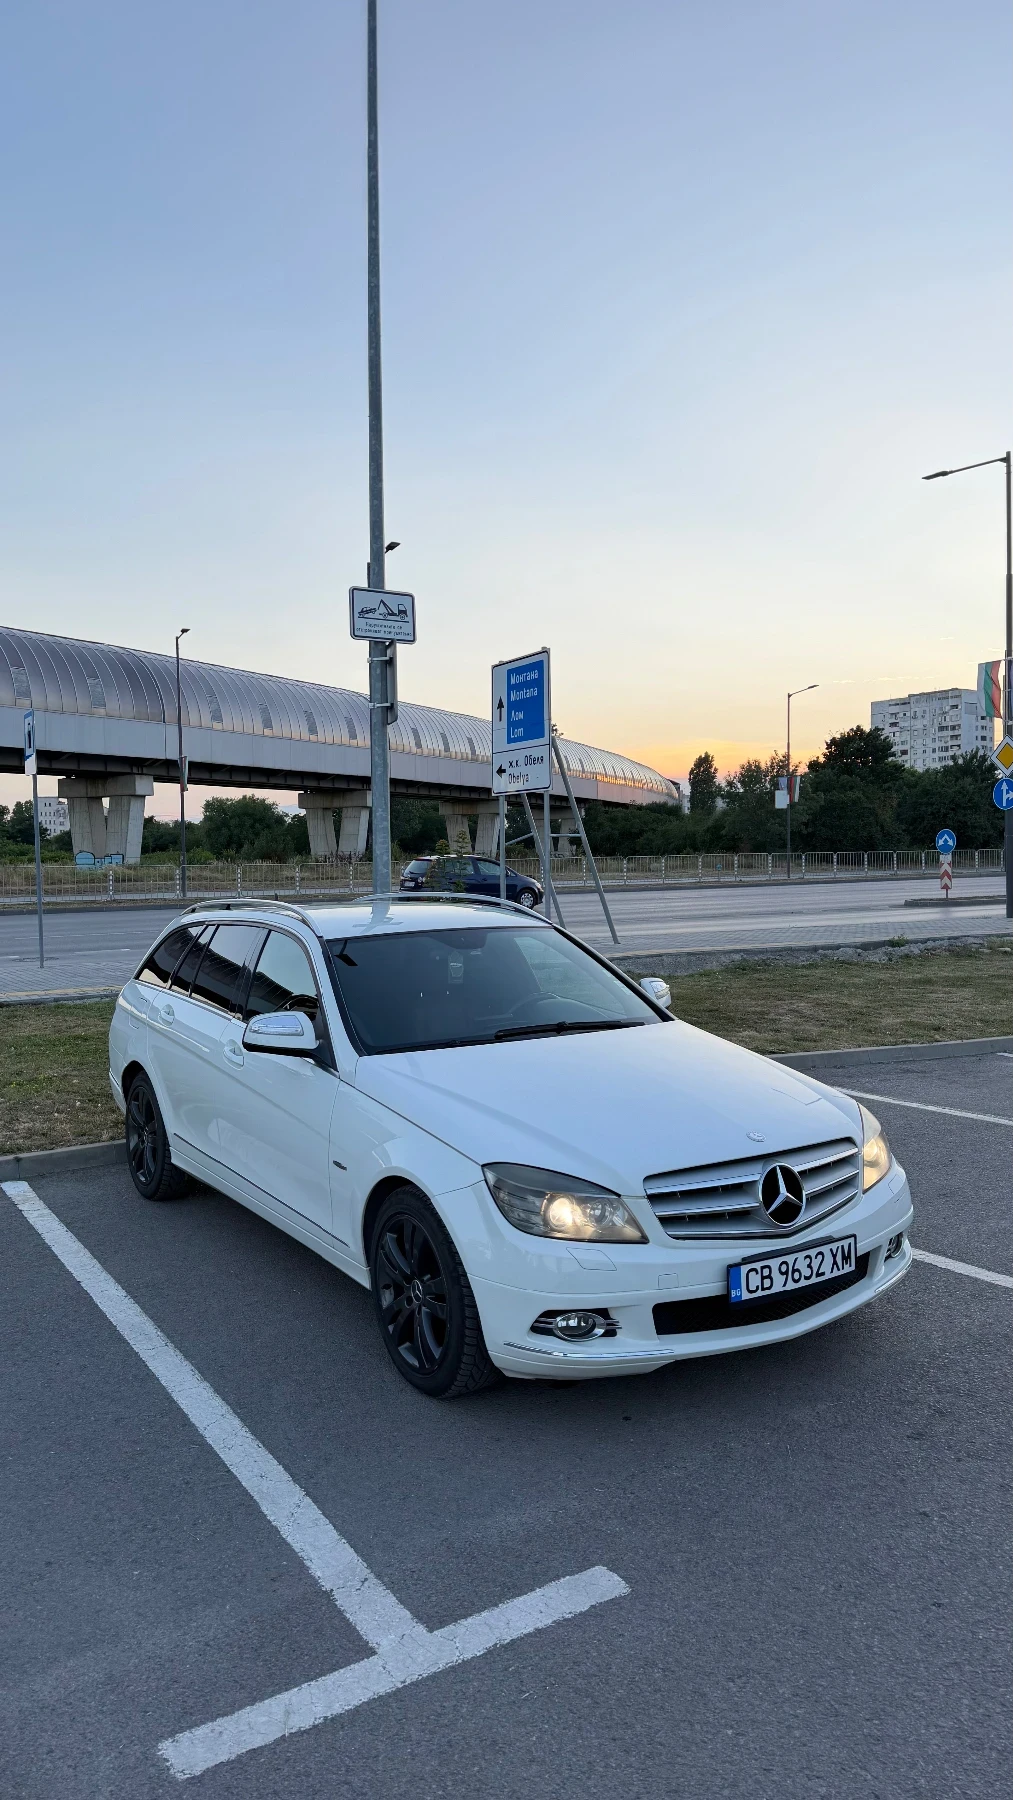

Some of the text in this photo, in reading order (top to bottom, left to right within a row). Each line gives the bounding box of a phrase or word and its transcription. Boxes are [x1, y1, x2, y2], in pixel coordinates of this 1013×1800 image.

[511, 670, 538, 684] Монтана
[511, 688, 538, 701] Montana
[511, 710, 523, 721] Лом
[511, 727, 523, 738] Lom
[508, 755, 544, 768] ж.к. Обеля
[508, 772, 529, 785] Obelya
[746, 1242, 852, 1294] CB 9632 XM
[731, 1289, 741, 1297] BG
